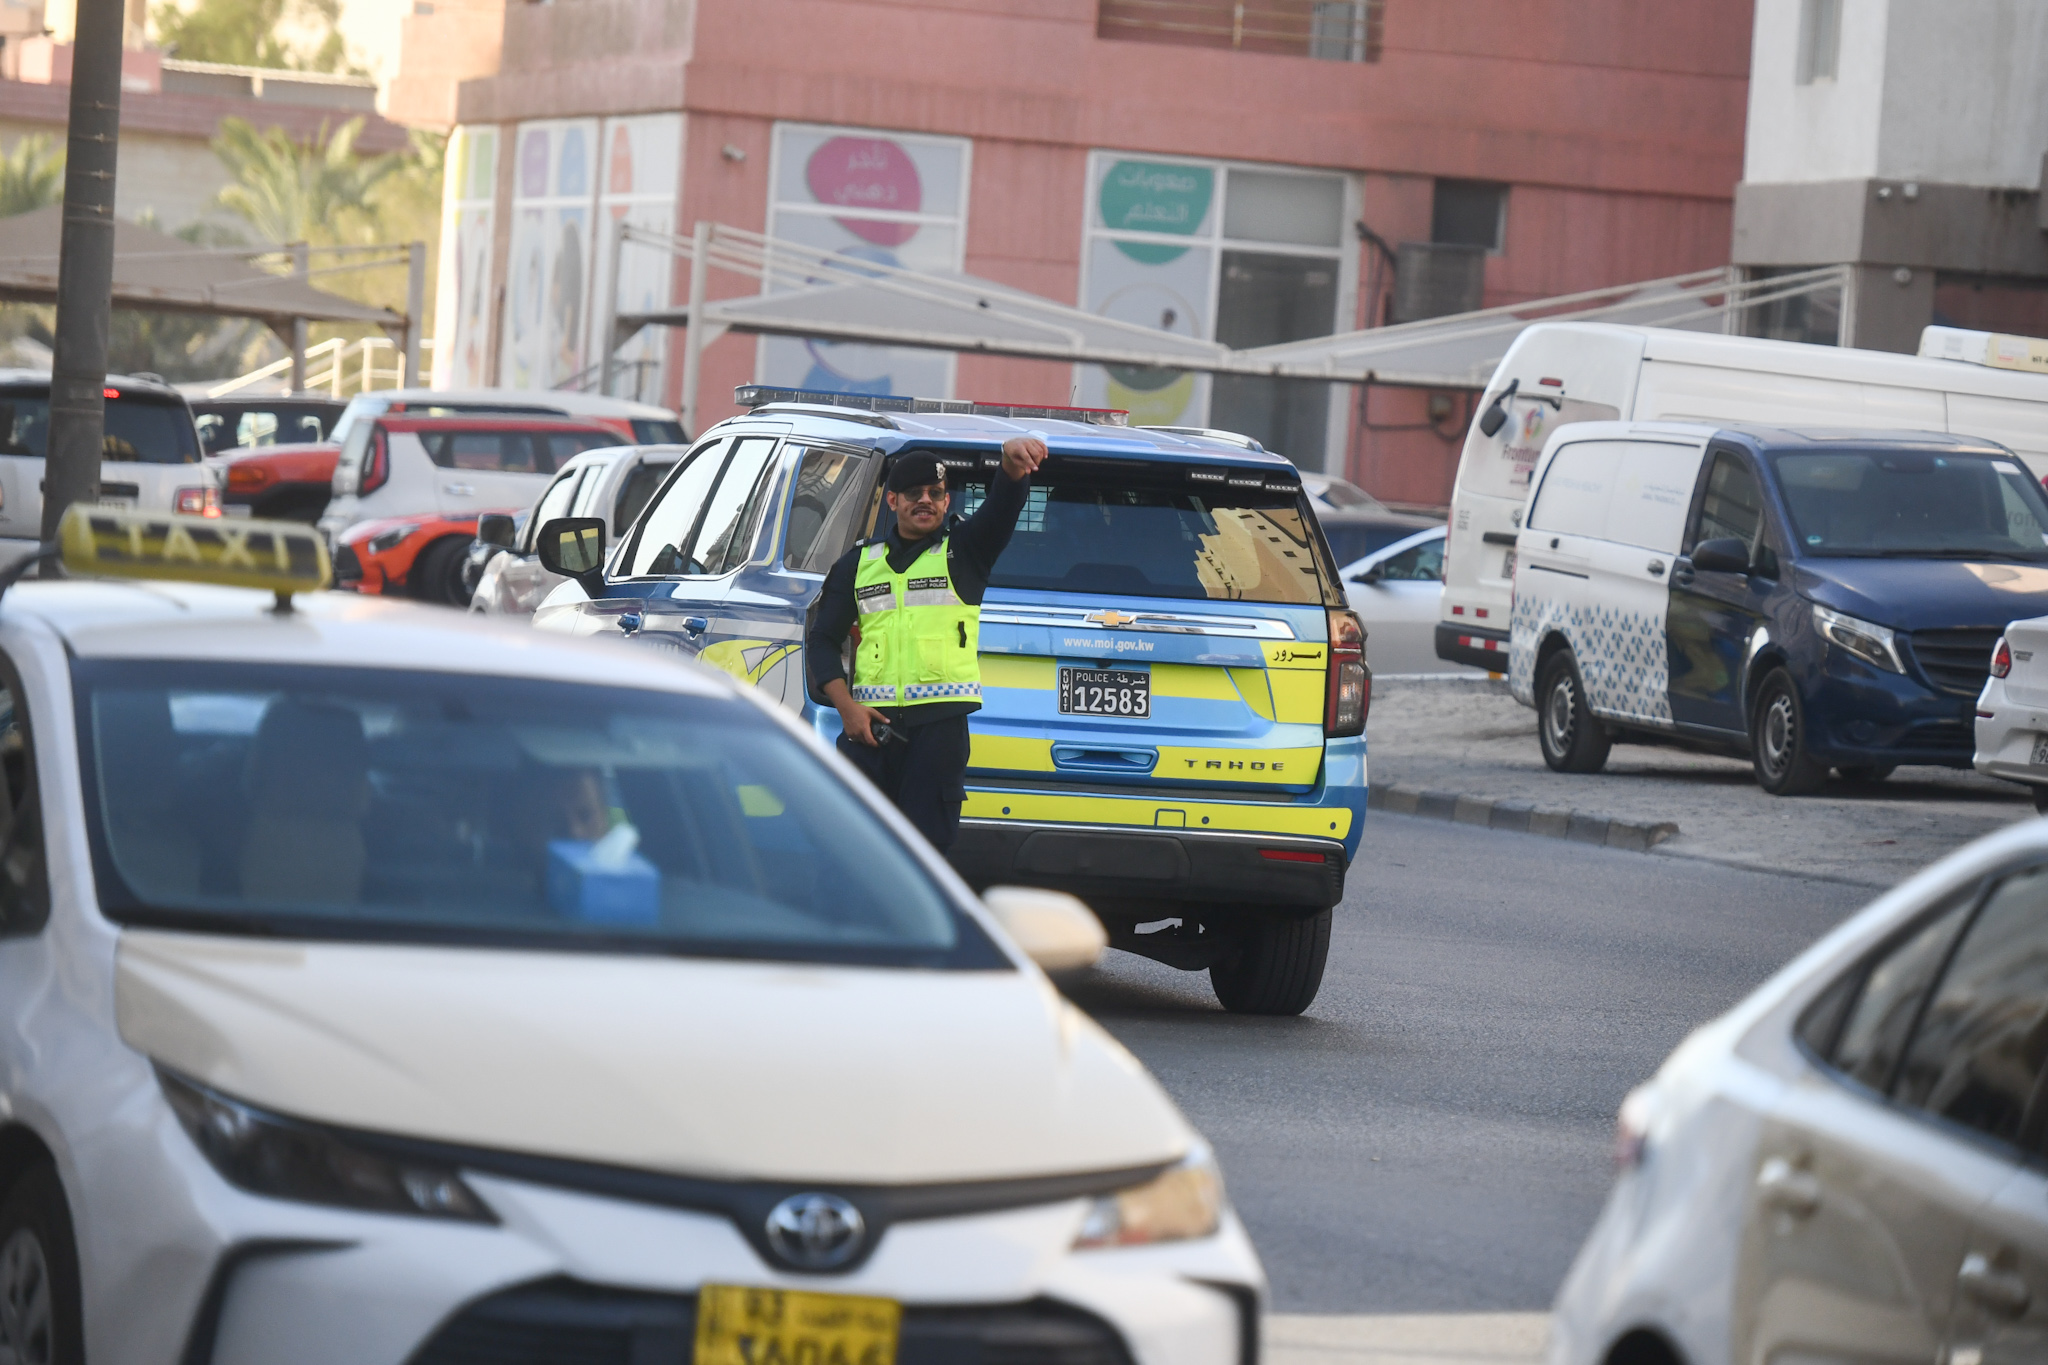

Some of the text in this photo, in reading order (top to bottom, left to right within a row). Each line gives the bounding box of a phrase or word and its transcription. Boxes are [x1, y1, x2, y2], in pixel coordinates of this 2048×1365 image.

[114, 516, 290, 571] TAXI
[1063, 637, 1155, 652] www.moi.gov.kw
[1076, 672, 1146, 686] POLICE شرطة
[1061, 669, 1070, 711] KUWAIT
[1074, 686, 1147, 714] 12583
[1184, 758, 1285, 770] TAHOE
